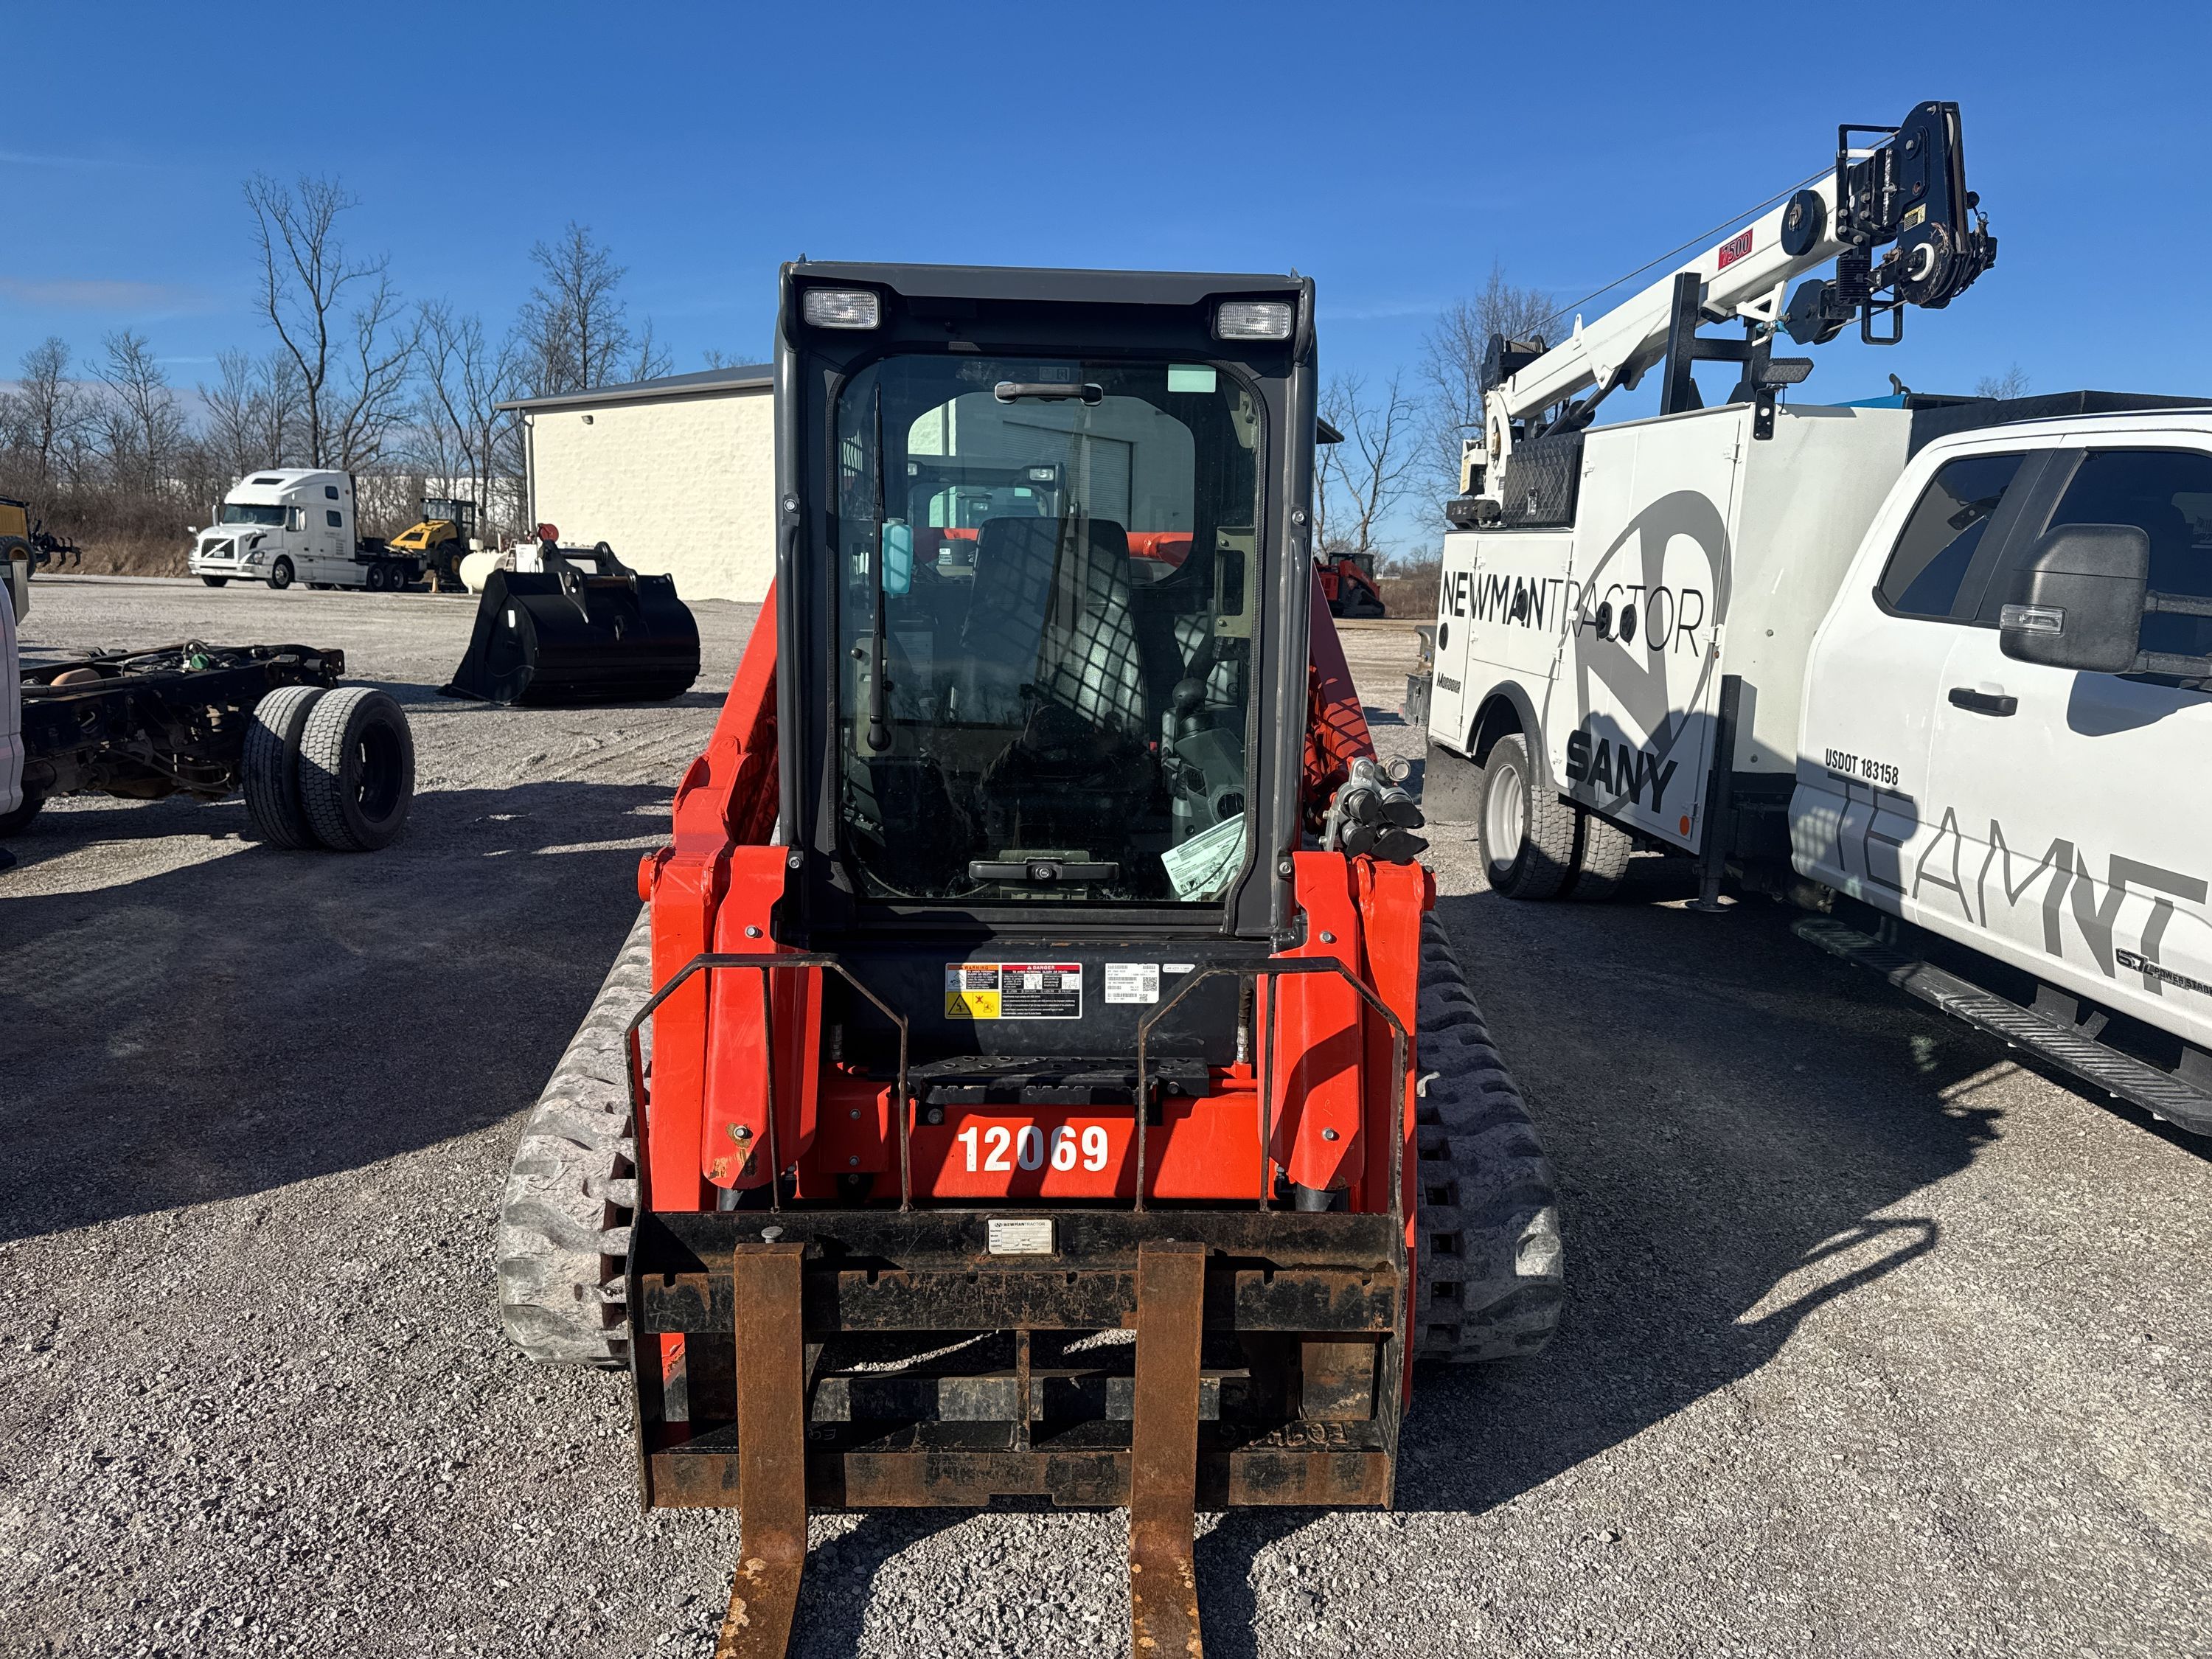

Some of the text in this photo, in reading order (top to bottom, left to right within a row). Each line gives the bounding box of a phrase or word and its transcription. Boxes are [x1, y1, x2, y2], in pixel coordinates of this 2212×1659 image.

[1721, 232, 1750, 266] 7500
[1565, 728, 1679, 815] SANY
[1825, 748, 1899, 787] USDOT 183158
[2154, 967, 2184, 985] POWER
[957, 1124, 1109, 1172] 12069
